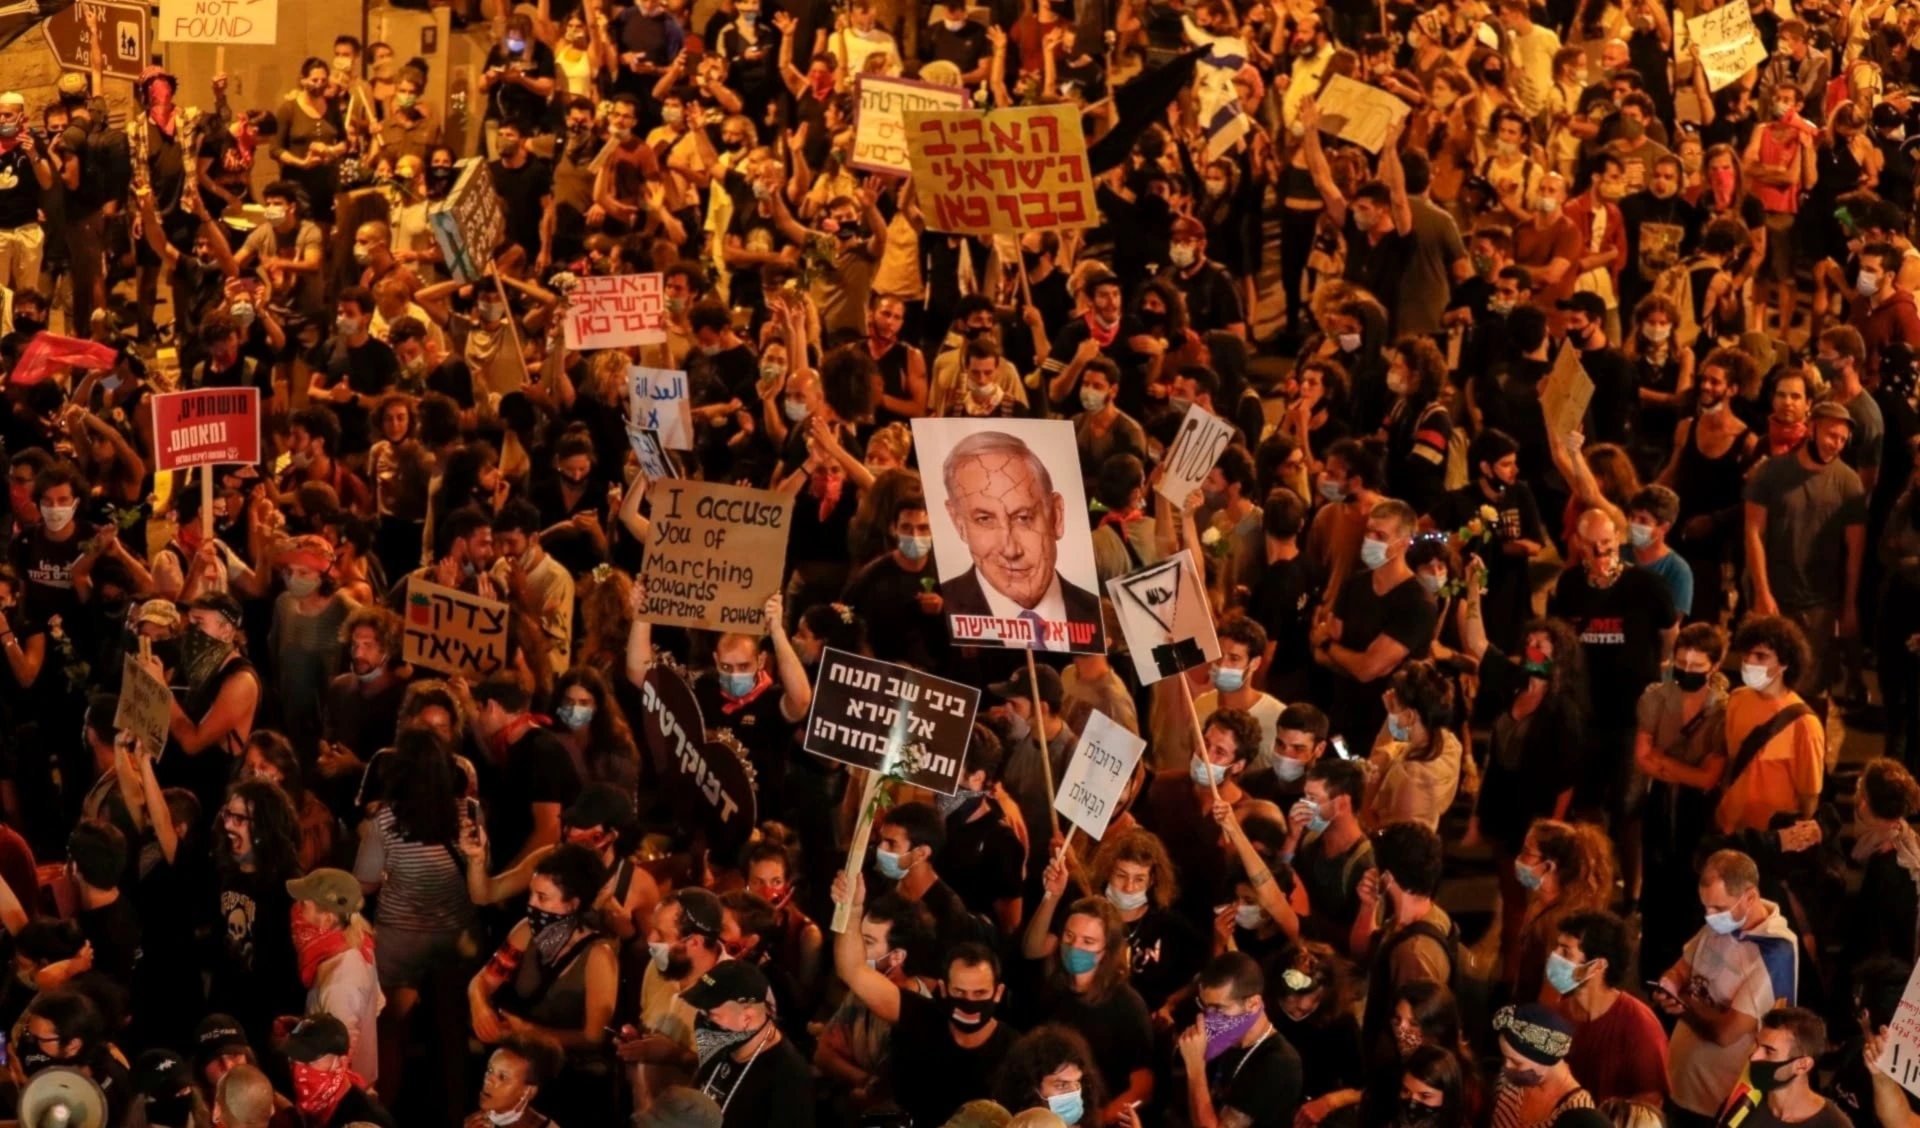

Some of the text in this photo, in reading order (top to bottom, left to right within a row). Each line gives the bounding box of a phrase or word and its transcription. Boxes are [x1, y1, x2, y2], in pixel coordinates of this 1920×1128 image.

[196, 0, 238, 16] NOT
[175, 17, 253, 38] FOUND
[920, 116, 1060, 156] האביב
[931, 155, 1084, 191] הישראלי
[934, 190, 1086, 231] כבר כאן
[568, 275, 659, 295] האביב
[575, 313, 663, 345] כבר כאן
[178, 394, 248, 423] מושחתים,
[167, 421, 227, 453] נמאסתם.
[665, 488, 783, 528] I accuse
[704, 528, 726, 550] of
[643, 573, 719, 601] towards
[646, 552, 754, 590] Marching
[432, 593, 506, 635] צדק
[955, 616, 1097, 644] ישראל מתביישת
[405, 629, 503, 676] לאיאד
[828, 663, 967, 718] ביבי שב תנוח
[846, 698, 936, 740] אל תירא
[642, 680, 739, 824] דמוקרטיה
